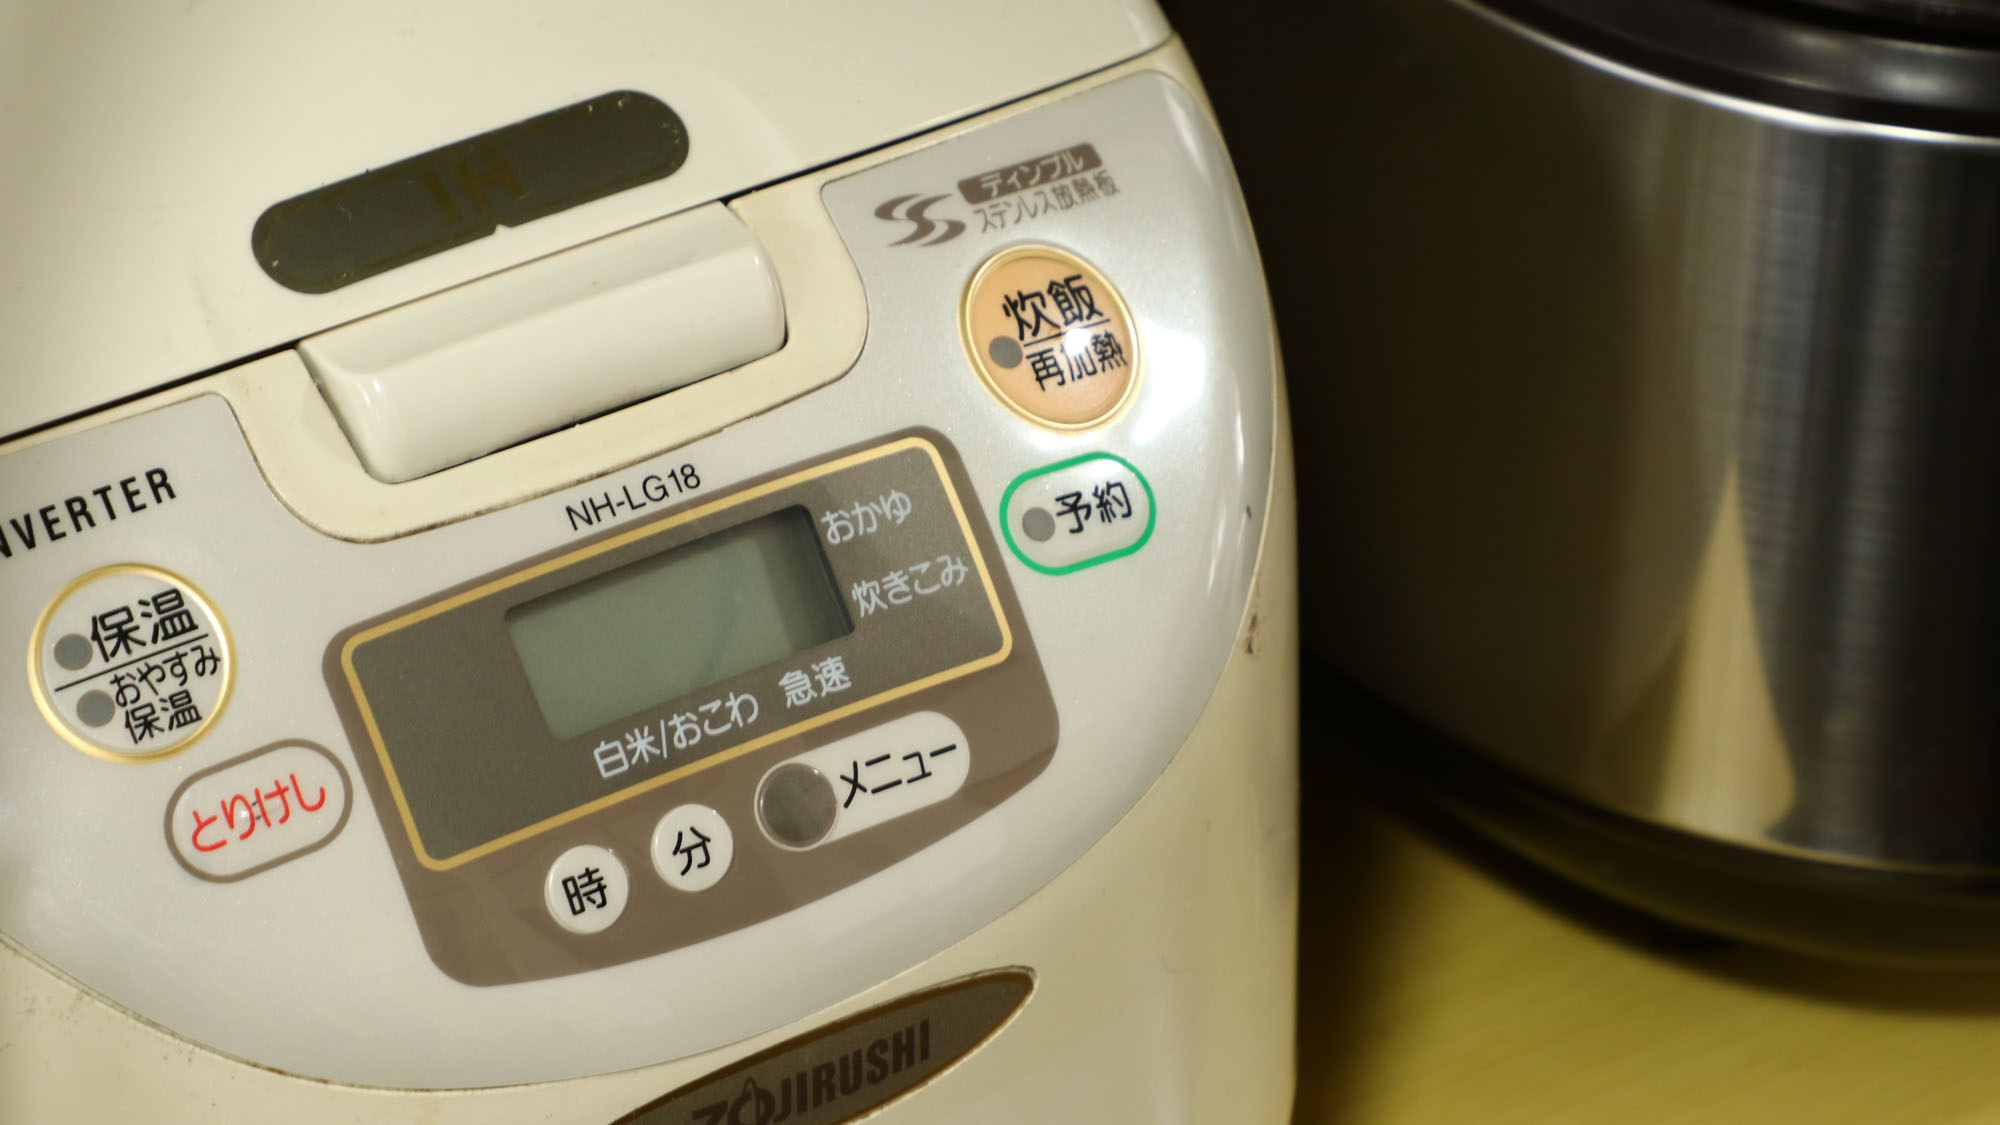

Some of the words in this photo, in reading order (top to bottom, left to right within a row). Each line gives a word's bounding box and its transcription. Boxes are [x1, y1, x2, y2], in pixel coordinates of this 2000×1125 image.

[973, 169, 1120, 233] ステンレス放熱板
[982, 149, 1083, 197] ディンプル
[1002, 274, 1103, 341] 炊飯
[1026, 330, 1128, 391] 再加熱
[565, 463, 701, 531] NH-LG18
[821, 489, 912, 545] おかゆ
[1055, 481, 1132, 534] 予約
[851, 555, 969, 619] 炊きこみ
[90, 588, 199, 662] 保温
[110, 645, 221, 707] おやすみ
[778, 655, 852, 709] 急速
[124, 689, 202, 744] 保温
[593, 691, 759, 779] 白米/おこわ
[839, 743, 957, 809] メニュー
[191, 773, 326, 852] とりけし
[672, 825, 711, 876] 分
[561, 866, 608, 917] 時
